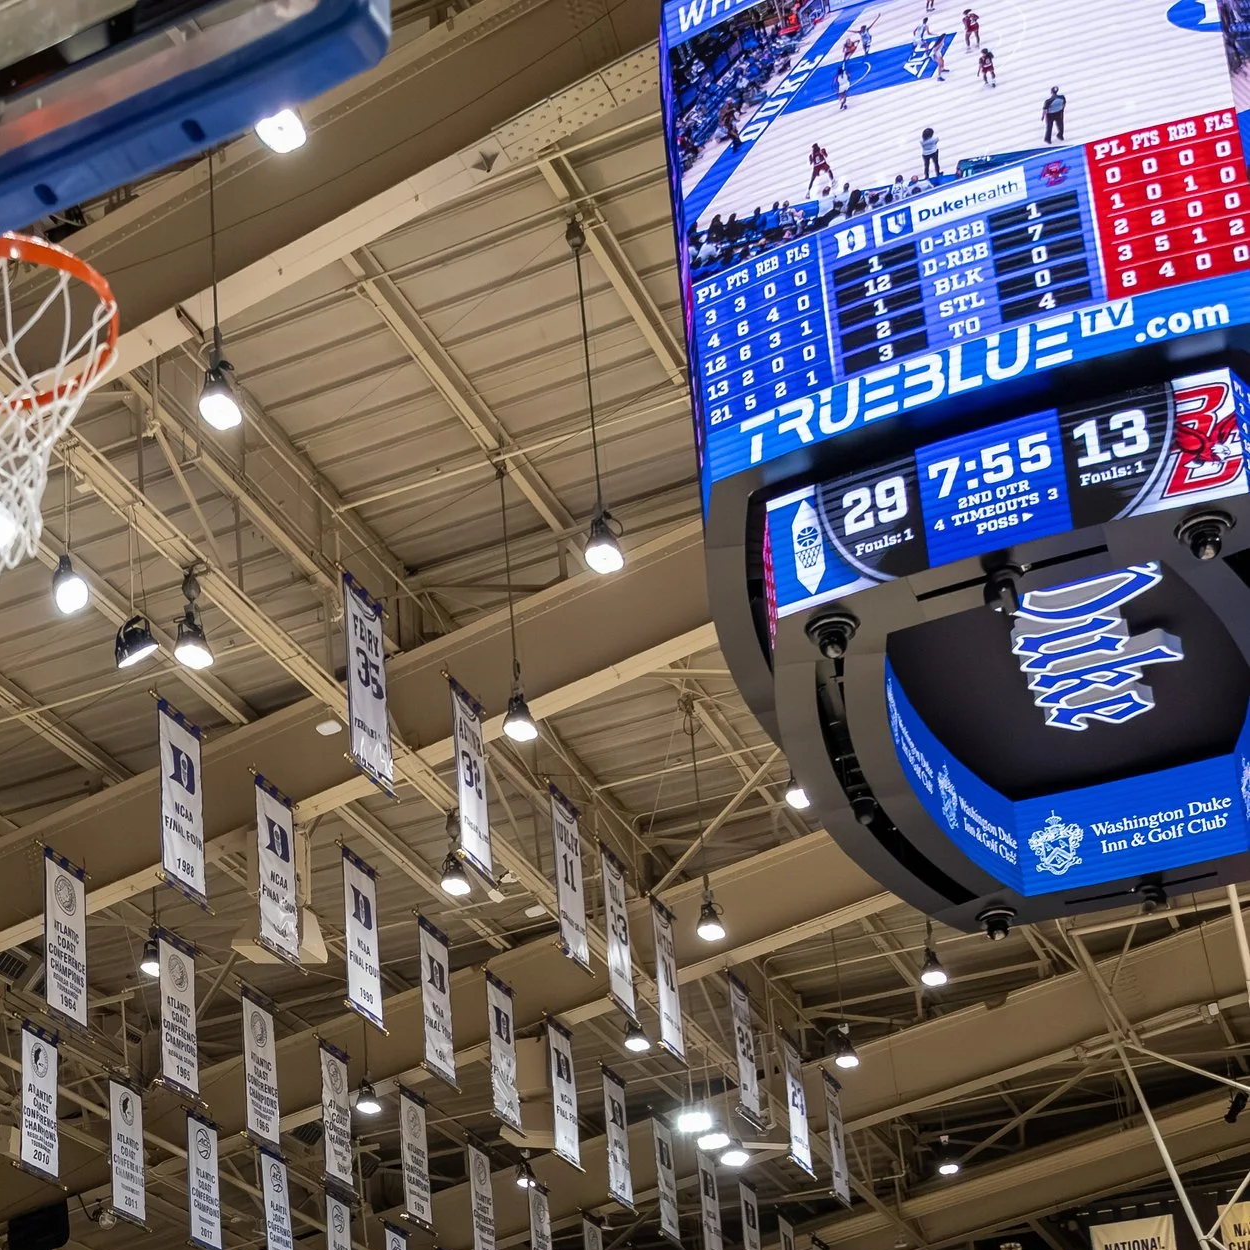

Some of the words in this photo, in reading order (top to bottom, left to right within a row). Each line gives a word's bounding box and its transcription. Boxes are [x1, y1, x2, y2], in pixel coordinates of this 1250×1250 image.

[740, 53, 823, 143] DUKE
[1093, 139, 1126, 160] PL
[1131, 130, 1160, 150] PTS
[1167, 120, 1197, 142] REB
[1204, 112, 1234, 133] FLS
[1105, 166, 1122, 184] 0
[1142, 157, 1158, 174] 0
[1178, 149, 1195, 166] 0
[1215, 140, 1232, 157] 0
[917, 180, 1020, 223] DukeHealth
[1110, 193, 1125, 209] 1
[1146, 183, 1162, 200] 0
[1184, 175, 1199, 192] 1
[1220, 166, 1236, 183] 0
[1114, 218, 1129, 236] 2
[1150, 209, 1166, 226] 2
[1187, 200, 1203, 218] 0
[1224, 192, 1241, 209] 0
[864, 274, 892, 297] 12
[922, 242, 989, 276] D-REB
[1027, 223, 1044, 241] 7
[868, 255, 883, 273] 1
[920, 219, 985, 254] O-REB
[1026, 203, 1042, 220] 1
[1117, 244, 1133, 261] 3
[1154, 234, 1171, 252] 5
[1192, 227, 1208, 244] 1
[1228, 218, 1246, 236] 2
[696, 283, 722, 304] PL
[726, 269, 749, 290] PTS
[755, 256, 779, 277] REB
[786, 243, 810, 264] FLS
[873, 299, 888, 316] 1
[933, 266, 984, 296] BLK
[1031, 246, 1048, 264] 0
[1121, 270, 1138, 288] 8
[1158, 261, 1176, 278] 4
[1196, 253, 1212, 270] 0
[1233, 245, 1250, 262] 0
[705, 309, 717, 325] 3
[734, 296, 746, 312] 3
[764, 282, 776, 299] 0
[794, 270, 807, 286] 0
[876, 320, 892, 339] 2
[939, 291, 985, 318] STL
[1034, 268, 1051, 287] 0
[707, 333, 720, 348] 4
[737, 320, 749, 336] 6
[766, 307, 779, 322] 4
[797, 295, 810, 311] 0
[878, 343, 894, 362] 3
[948, 316, 981, 339] TO
[1038, 292, 1056, 310] 4
[704, 355, 727, 376] 12
[739, 345, 751, 361] 6
[769, 332, 781, 348] 3
[800, 320, 812, 336] 1
[707, 380, 729, 400] 13
[742, 370, 754, 386] 2
[771, 357, 784, 373] 0
[803, 345, 815, 361] 0
[710, 405, 733, 426] 21
[744, 394, 756, 410] 5
[774, 381, 787, 398] 2
[806, 370, 818, 386] 1
[1071, 408, 1151, 468] 13
[928, 431, 1053, 499] 7:55
[1079, 464, 1133, 487] Fouls:
[1134, 460, 1146, 473] 1
[841, 475, 910, 537] 29
[933, 518, 946, 532] 4
[951, 494, 1040, 526] TIMEOUTS
[1047, 488, 1059, 501] 3
[957, 486, 994, 510] 2ND
[996, 479, 1030, 501] QTR
[855, 530, 902, 557] Fouls:
[903, 529, 914, 541] 1
[976, 513, 1019, 536] POSS
[1011, 561, 1184, 731] Duke
[356, 646, 384, 700] 35
[164, 815, 186, 840] FINAL
[186, 830, 203, 852] FOUR
[174, 801, 194, 824] NCAA
[1090, 807, 1184, 838] Washington
[1187, 796, 1232, 818] Duke
[1101, 838, 1128, 854] Inn
[1130, 832, 1147, 847] &
[1148, 822, 1184, 844] Golf
[1187, 814, 1227, 835] Club
[177, 858, 195, 878] 1988
[562, 852, 577, 893] 11
[33, 1149, 50, 1165] 2010
